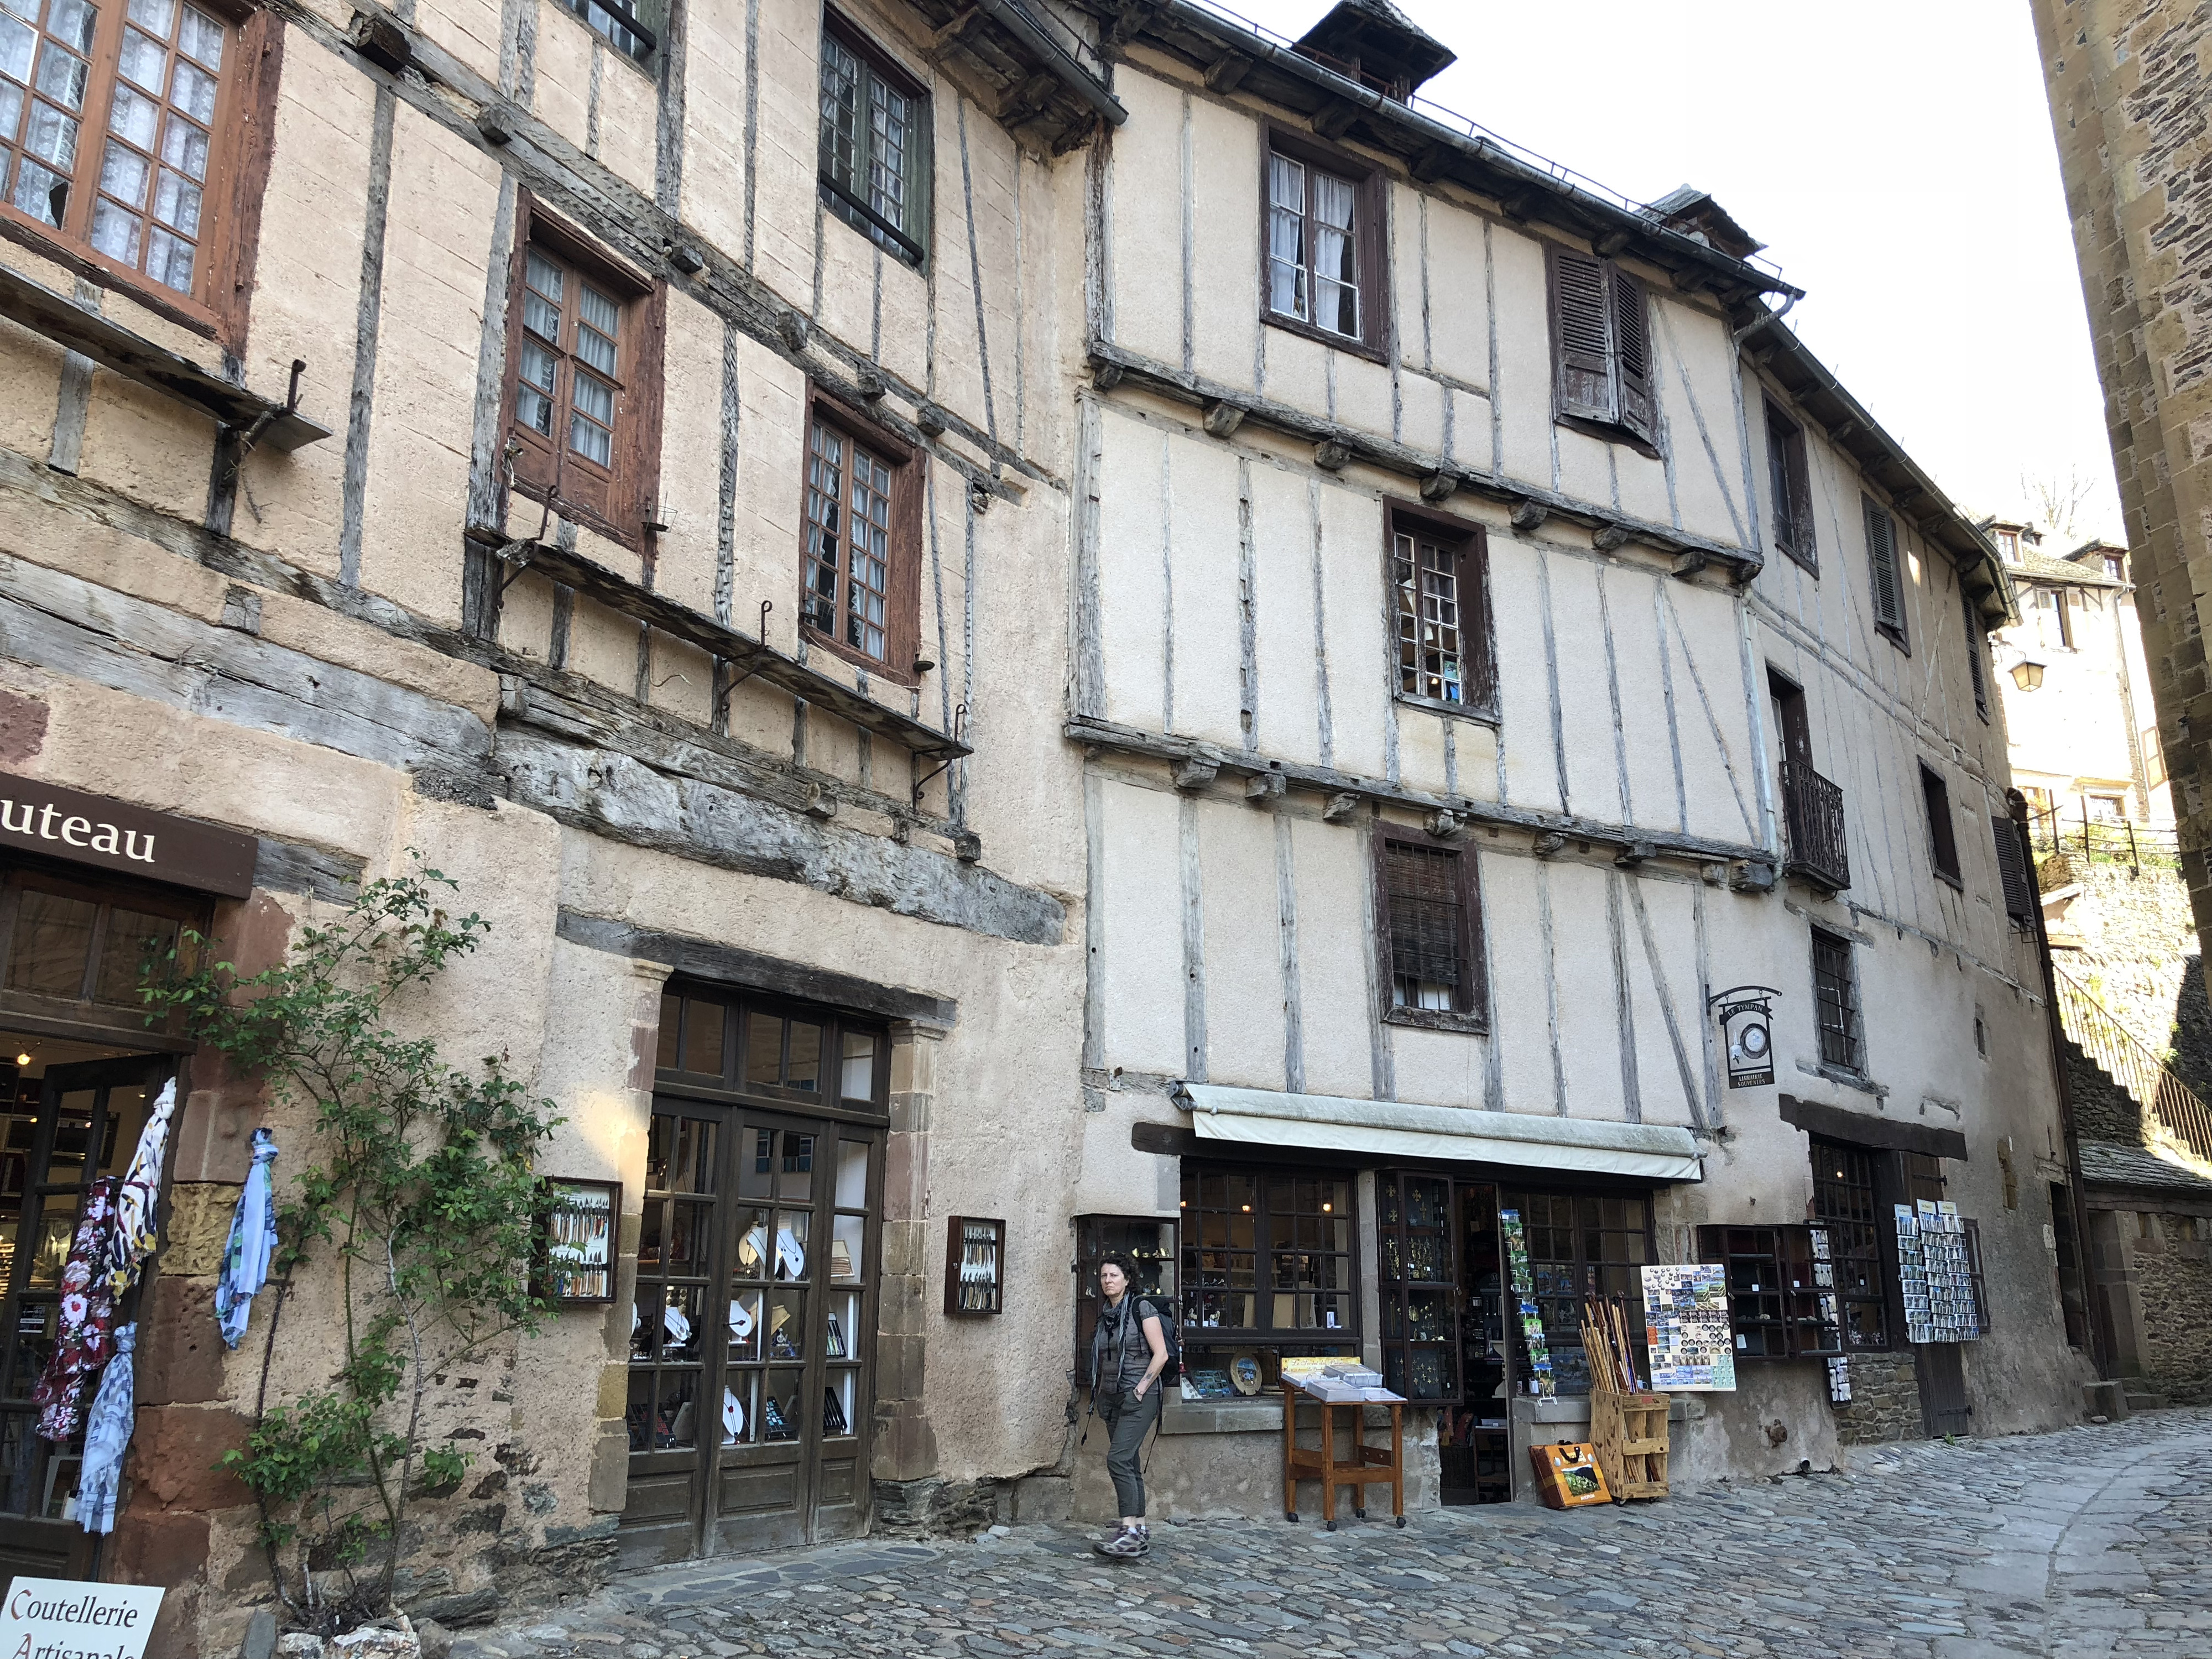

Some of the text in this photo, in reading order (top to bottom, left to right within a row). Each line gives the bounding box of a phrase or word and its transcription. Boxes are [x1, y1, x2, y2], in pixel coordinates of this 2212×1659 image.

[1728, 1004, 1763, 1016] LE TYMPAN
[1739, 1073, 1763, 1082] LIBRAIRIE
[1738, 1079, 1765, 1087] SOUVENIRS
[11, 1589, 138, 1628] Coutellerie
